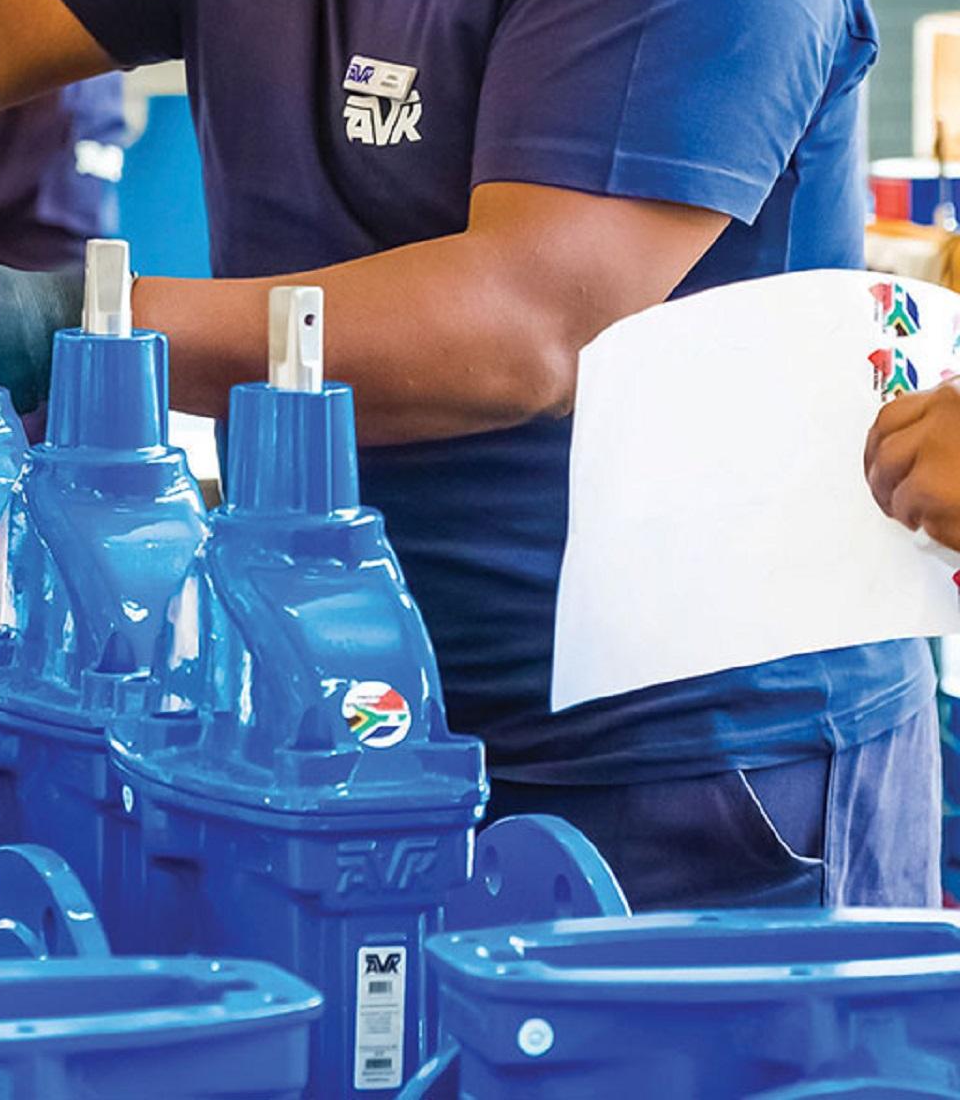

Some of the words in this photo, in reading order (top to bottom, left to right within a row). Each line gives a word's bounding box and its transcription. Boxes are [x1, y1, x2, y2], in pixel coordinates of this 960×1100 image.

[346, 63, 375, 85] AVK
[343, 89, 422, 146] AVK
[364, 953, 401, 975] AVK
